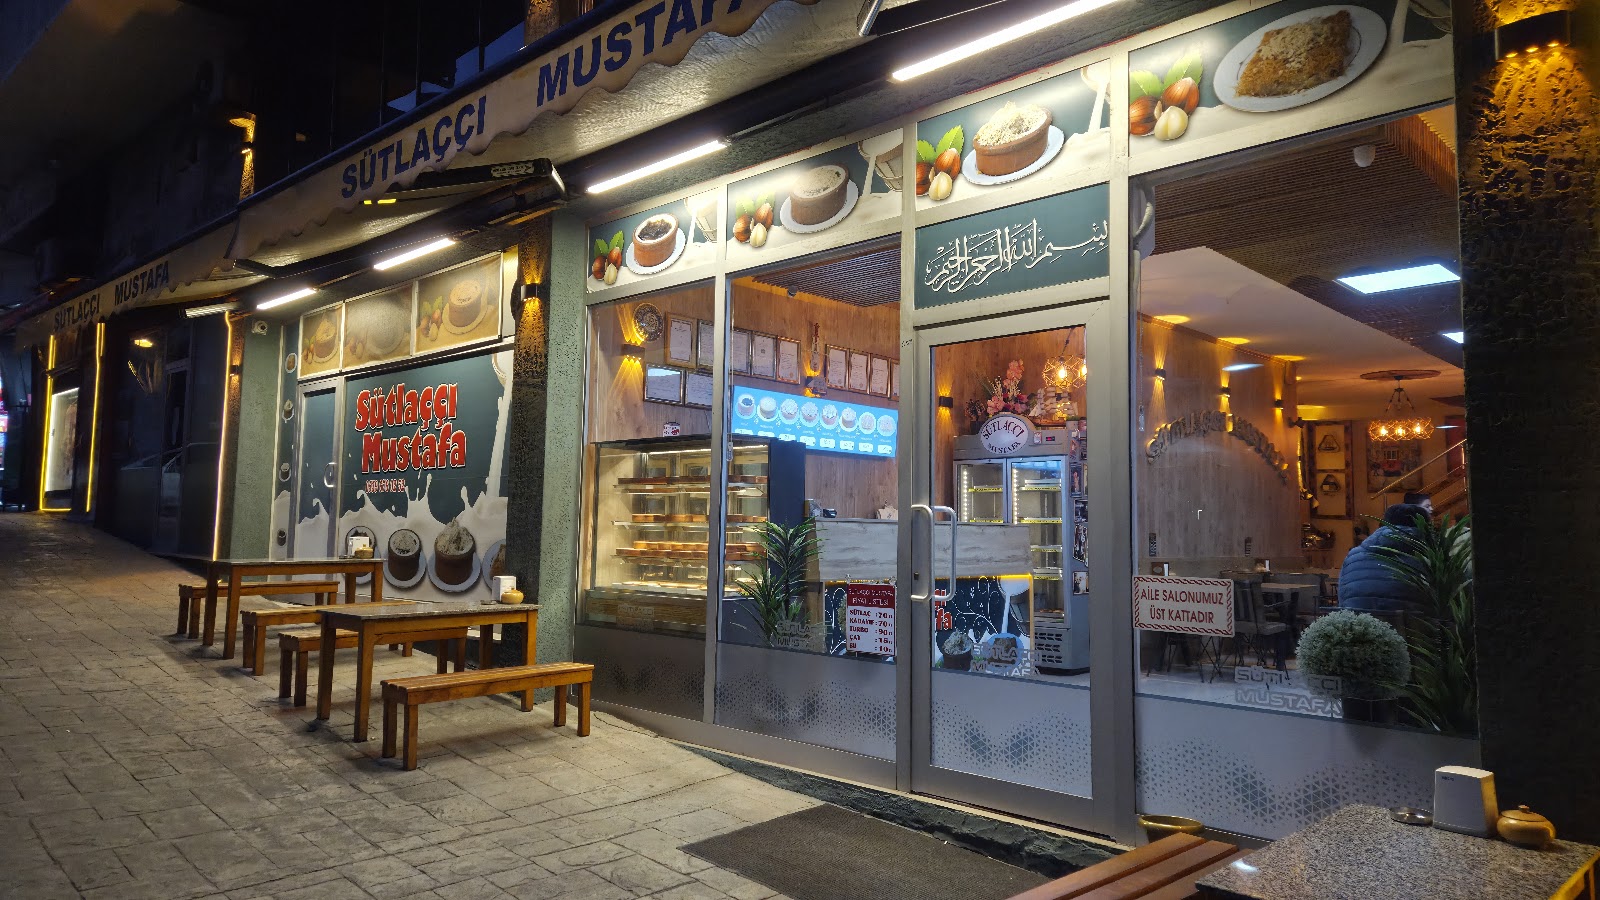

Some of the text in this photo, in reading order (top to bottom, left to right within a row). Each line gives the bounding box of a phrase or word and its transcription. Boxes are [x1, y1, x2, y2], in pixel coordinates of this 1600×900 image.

[341, 0, 742, 198] SÜTLAÇÇI MUSTA
[114, 261, 169, 307] MUSTAFA
[355, 383, 458, 431] Sütlaççı
[361, 421, 467, 474] Mustafa
[1141, 586, 1224, 605] AİLE SALONUMUZ
[1150, 605, 1214, 624] ÜST KATTADIR
[1237, 688, 1342, 715] MUSTAFA
